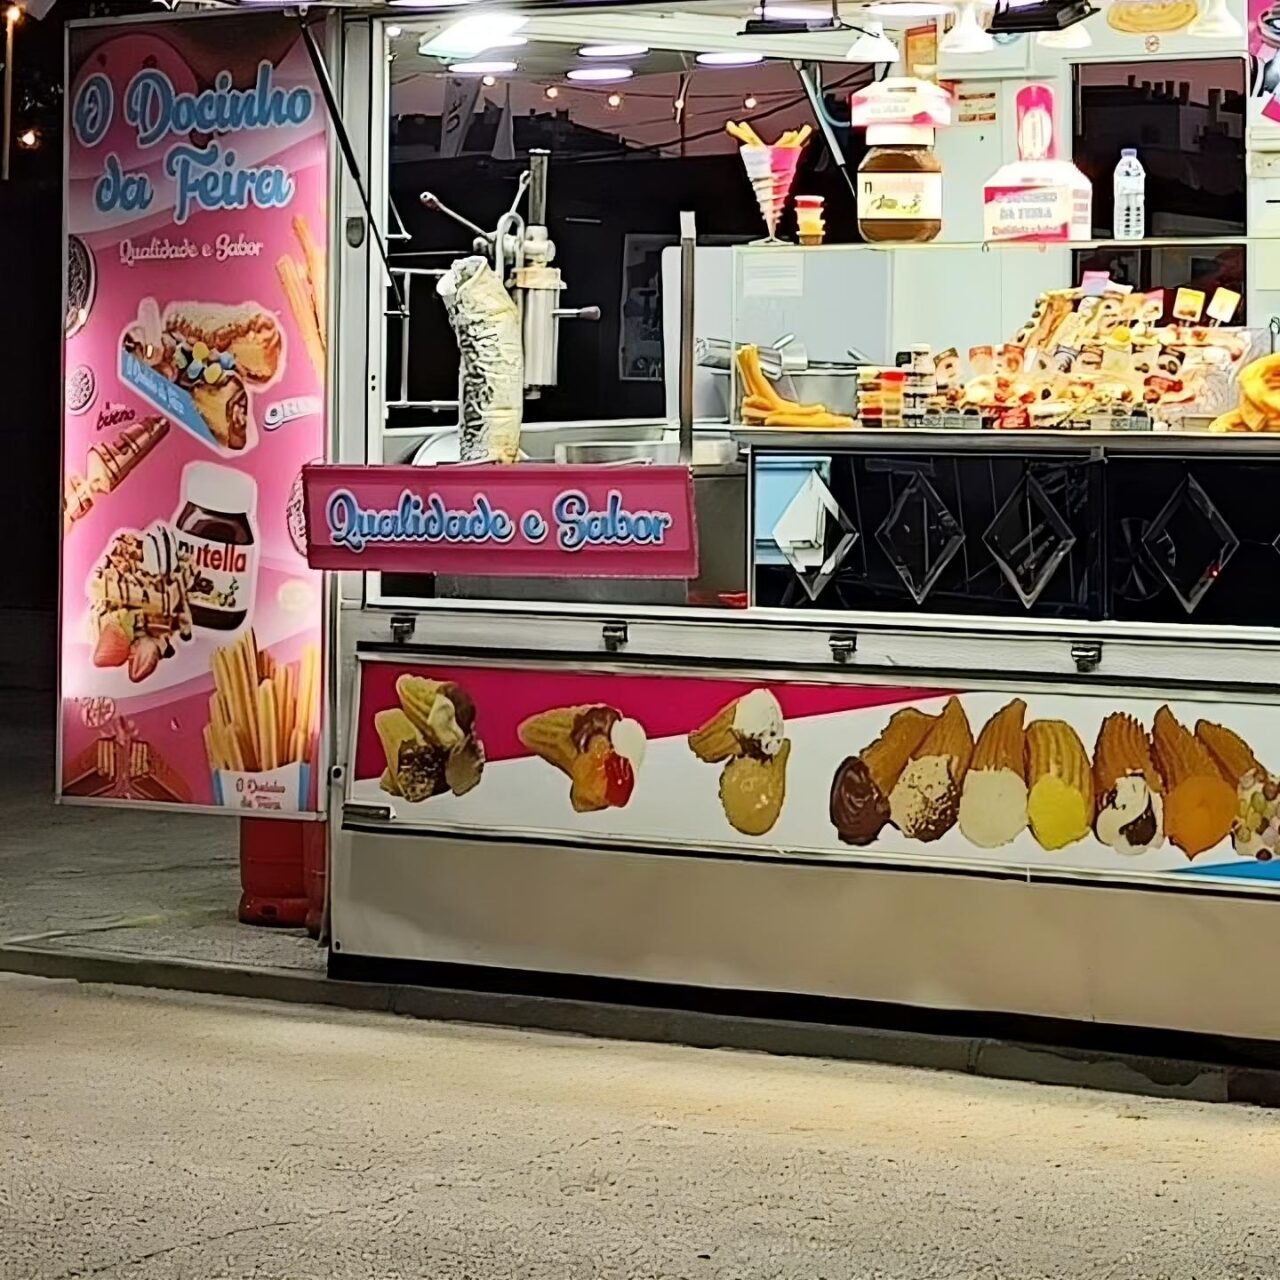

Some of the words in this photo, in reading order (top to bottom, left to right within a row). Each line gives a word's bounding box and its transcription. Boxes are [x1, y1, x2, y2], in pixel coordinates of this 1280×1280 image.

[73, 72, 113, 147] O
[124, 59, 314, 149] Docinho
[93, 152, 153, 212] da
[164, 140, 295, 225] Feira
[119, 237, 198, 267] Qualidade
[202, 243, 213, 257] e
[215, 233, 263, 261] Sabor
[326, 488, 512, 554] Qualidade
[520, 509, 547, 544] e
[553, 489, 673, 553] Sabor
